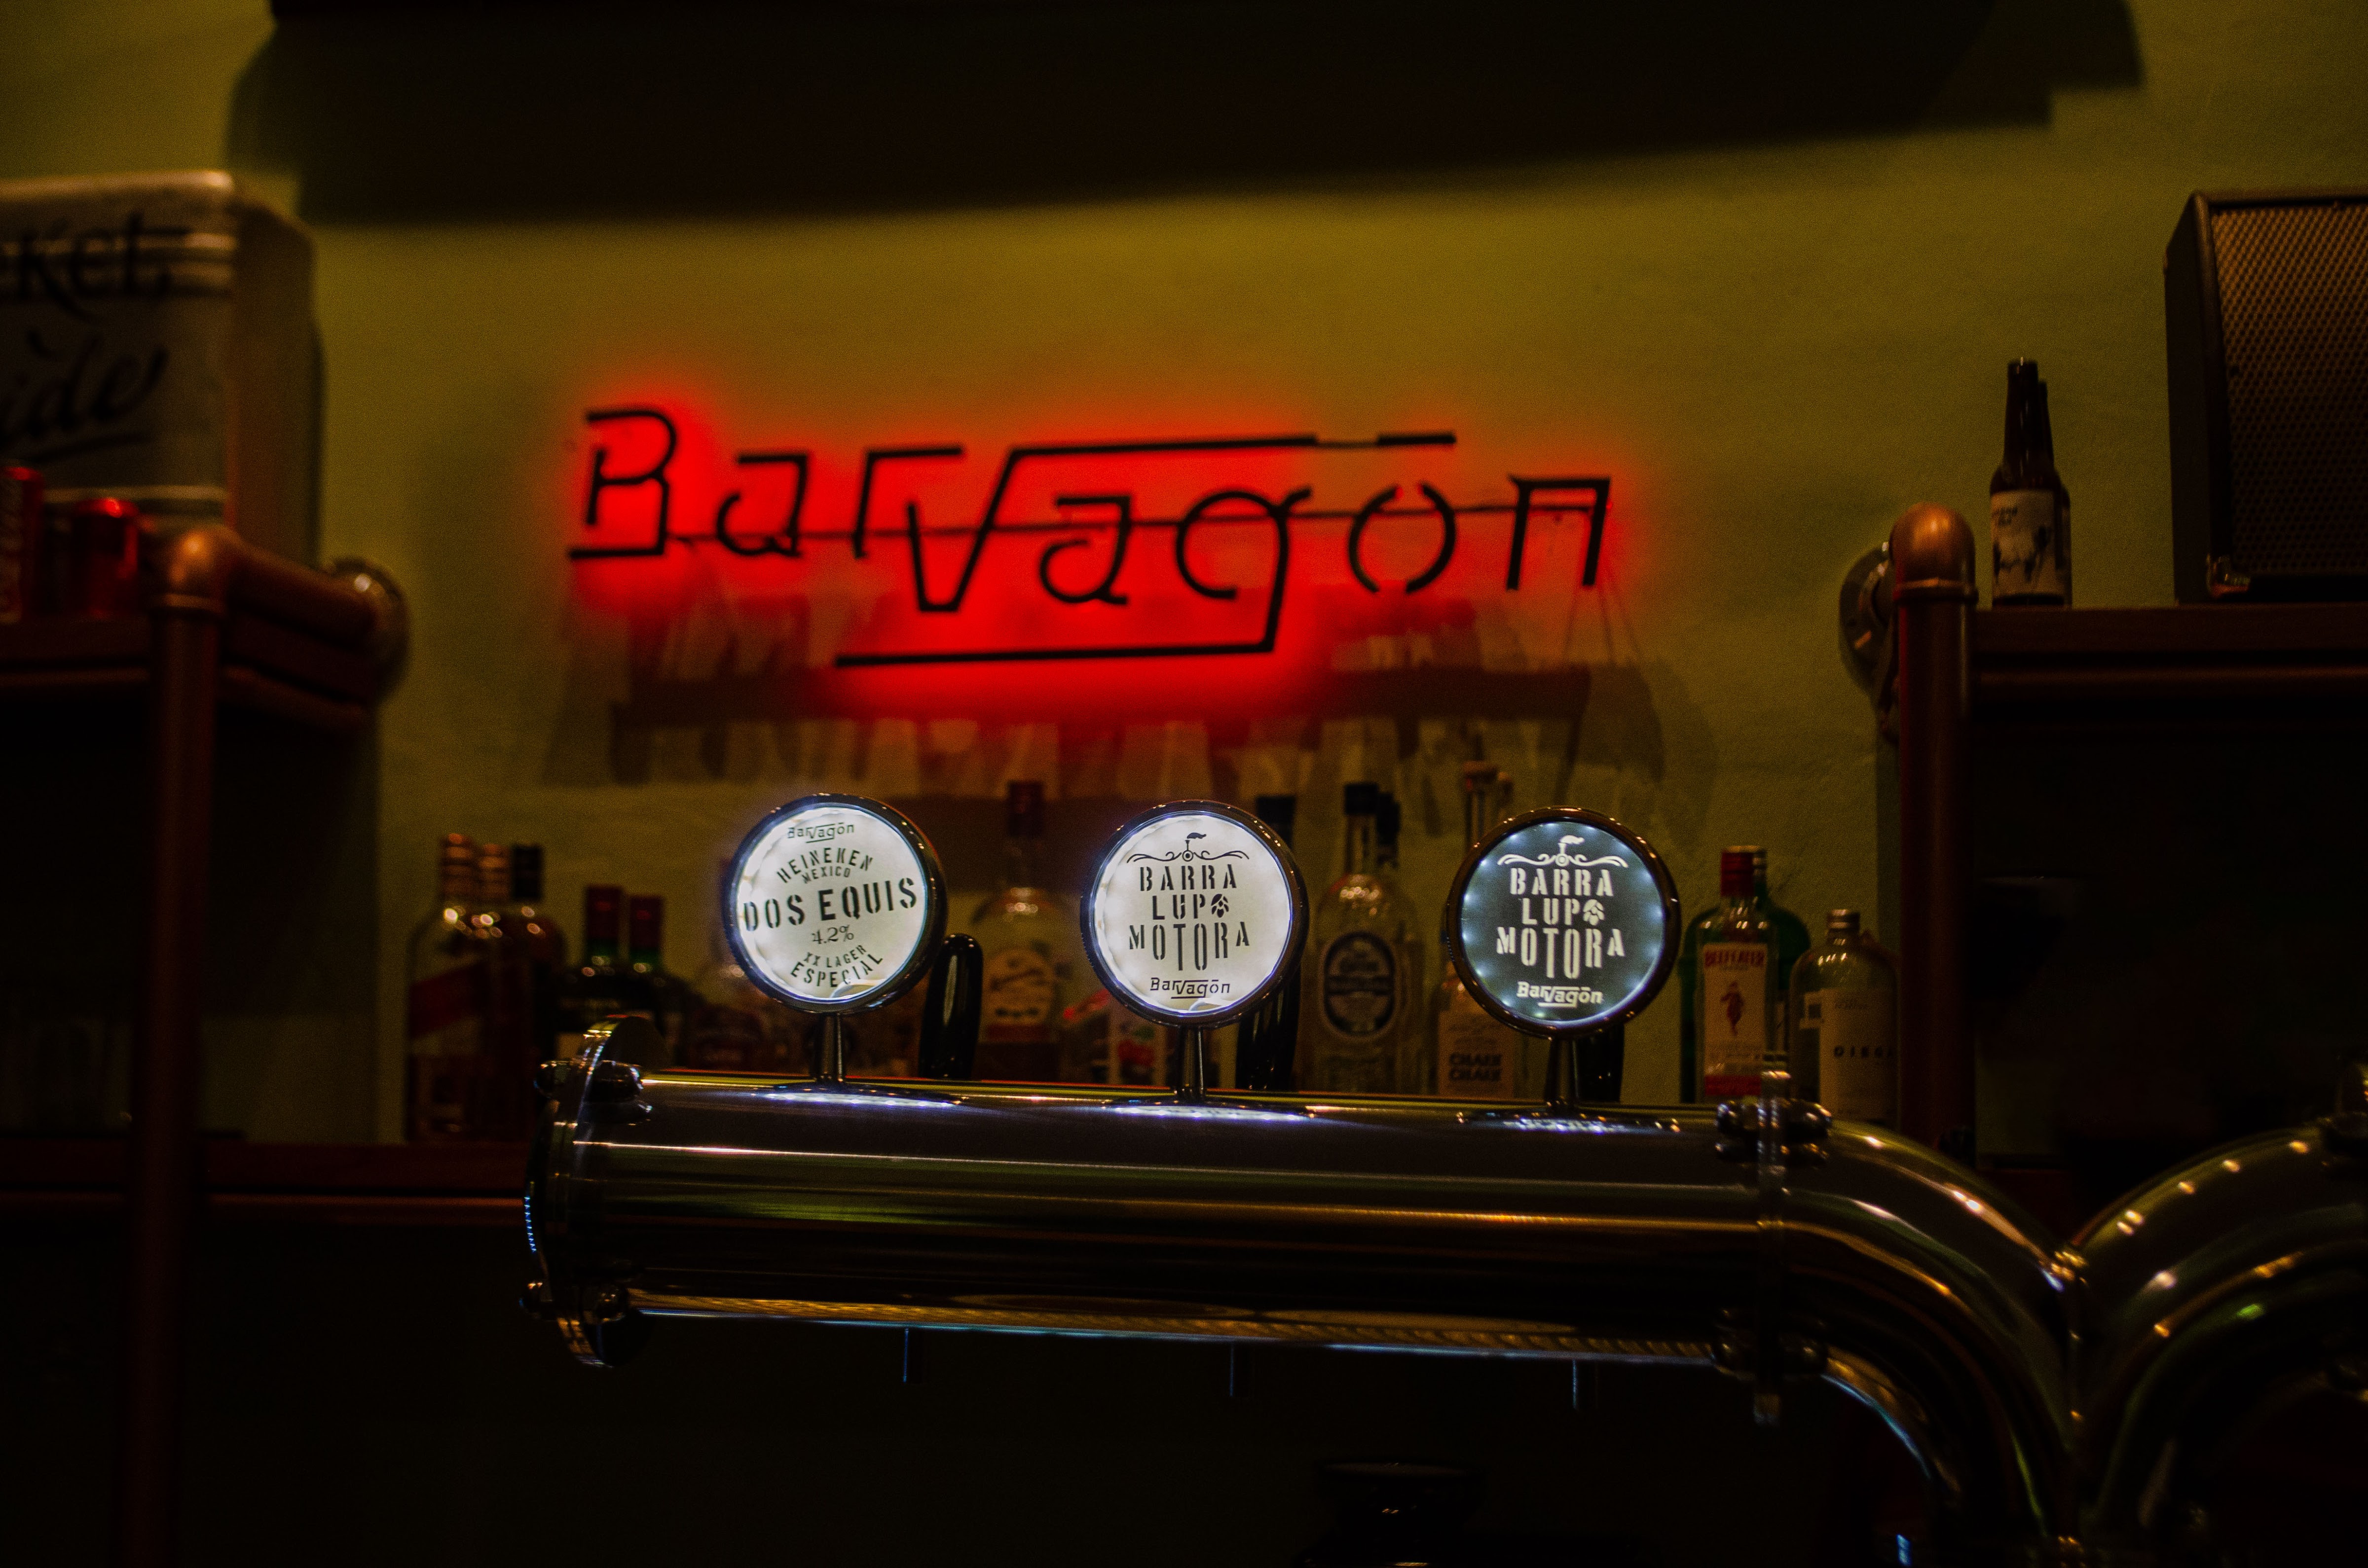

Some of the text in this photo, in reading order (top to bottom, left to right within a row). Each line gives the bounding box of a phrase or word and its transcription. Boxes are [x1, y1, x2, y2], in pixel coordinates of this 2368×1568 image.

[777, 847, 873, 883] HEINEKEN
[802, 866, 851, 884] MEXICO
[1140, 864, 1237, 891] BARRA
[1510, 868, 1614, 897] BARRA
[743, 878, 917, 931] DOS EQUIS
[812, 925, 854, 944] 4.2%
[1129, 921, 1250, 971] MOTORA
[804, 945, 867, 968] XX LAGER
[1496, 926, 1625, 979] MOTORA
[790, 953, 883, 987] ESPECIAL
